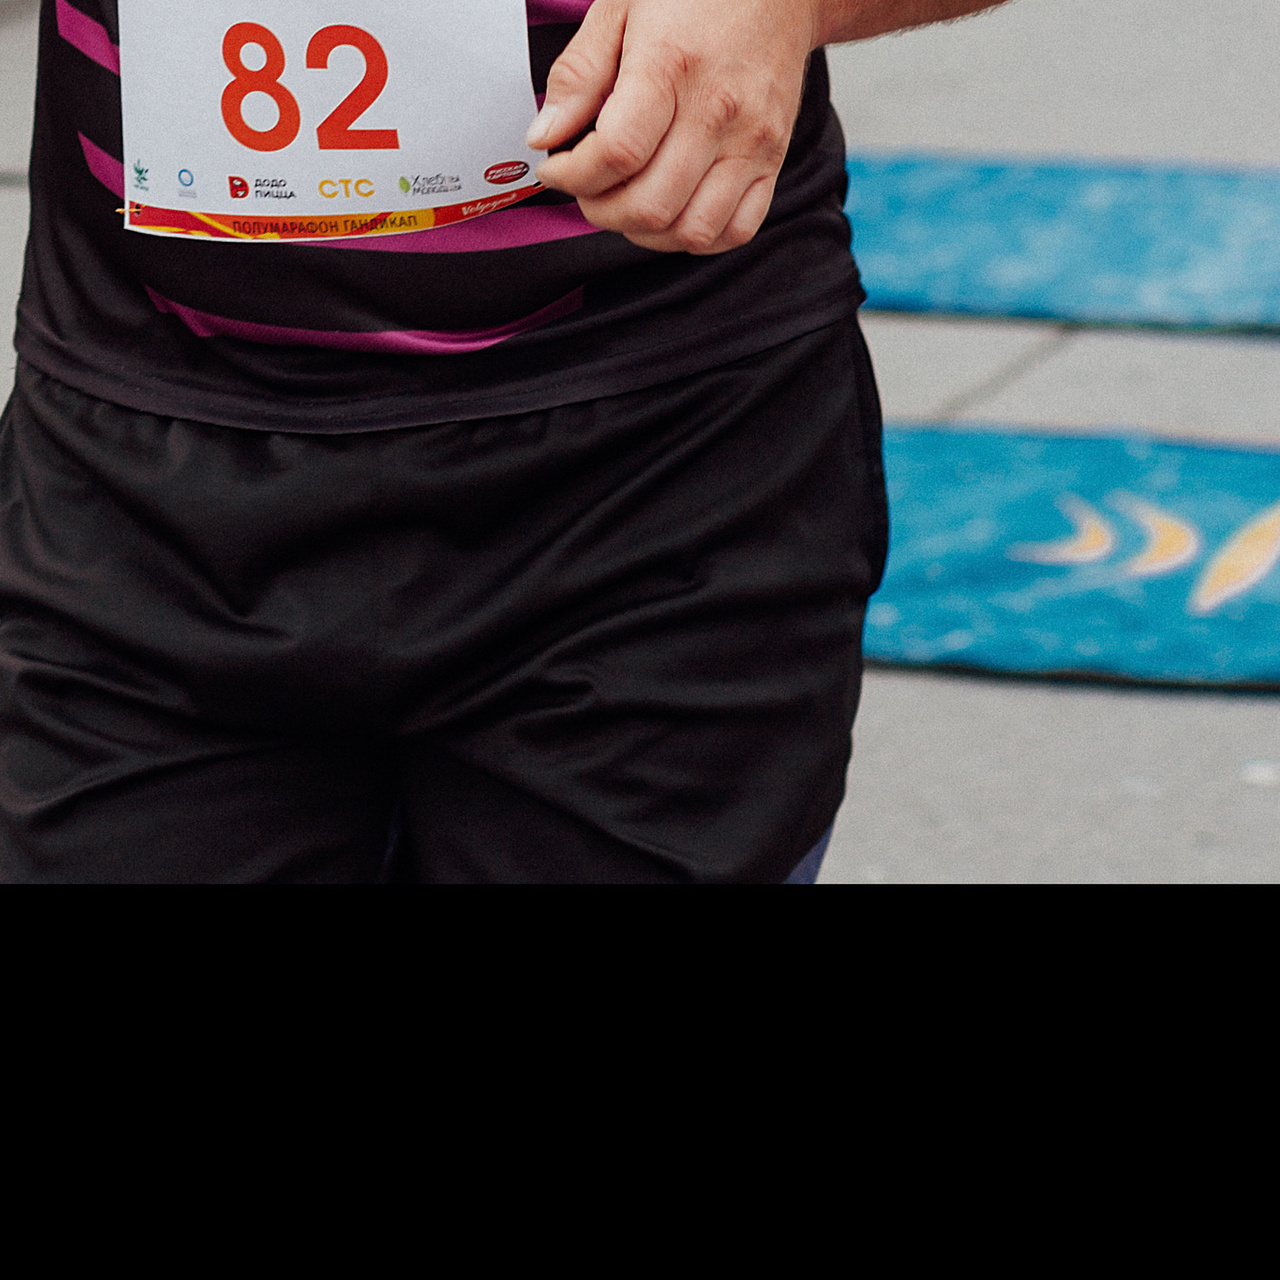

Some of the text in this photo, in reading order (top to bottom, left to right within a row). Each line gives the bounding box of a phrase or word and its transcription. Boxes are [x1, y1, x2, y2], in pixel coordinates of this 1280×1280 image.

[220, 21, 400, 152] 82
[318, 178, 375, 199] СТС
[233, 215, 418, 235] ПОЛУМАРАФОН ГАНДИКАП
